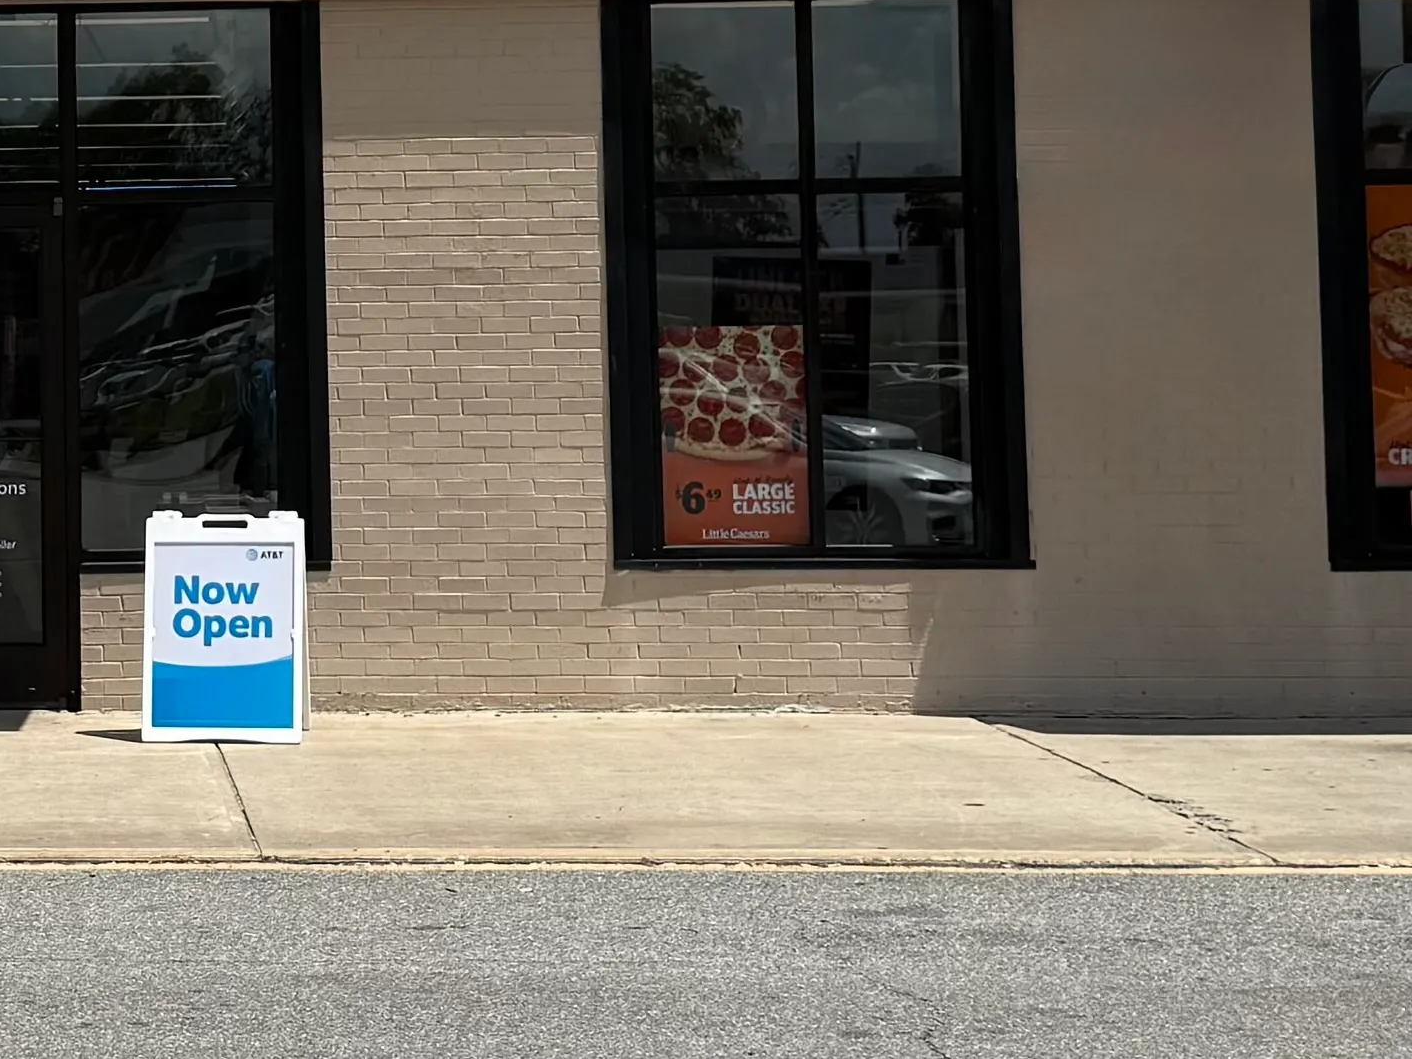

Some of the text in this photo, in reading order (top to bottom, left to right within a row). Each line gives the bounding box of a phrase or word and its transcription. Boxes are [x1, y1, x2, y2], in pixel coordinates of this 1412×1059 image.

[732, 482, 796, 500] LARGE
[732, 500, 796, 515] CLASSIC
[702, 527, 770, 540] Little Caesars
[260, 550, 284, 560] AT&T
[173, 575, 260, 605] Now
[172, 607, 273, 647] Open
